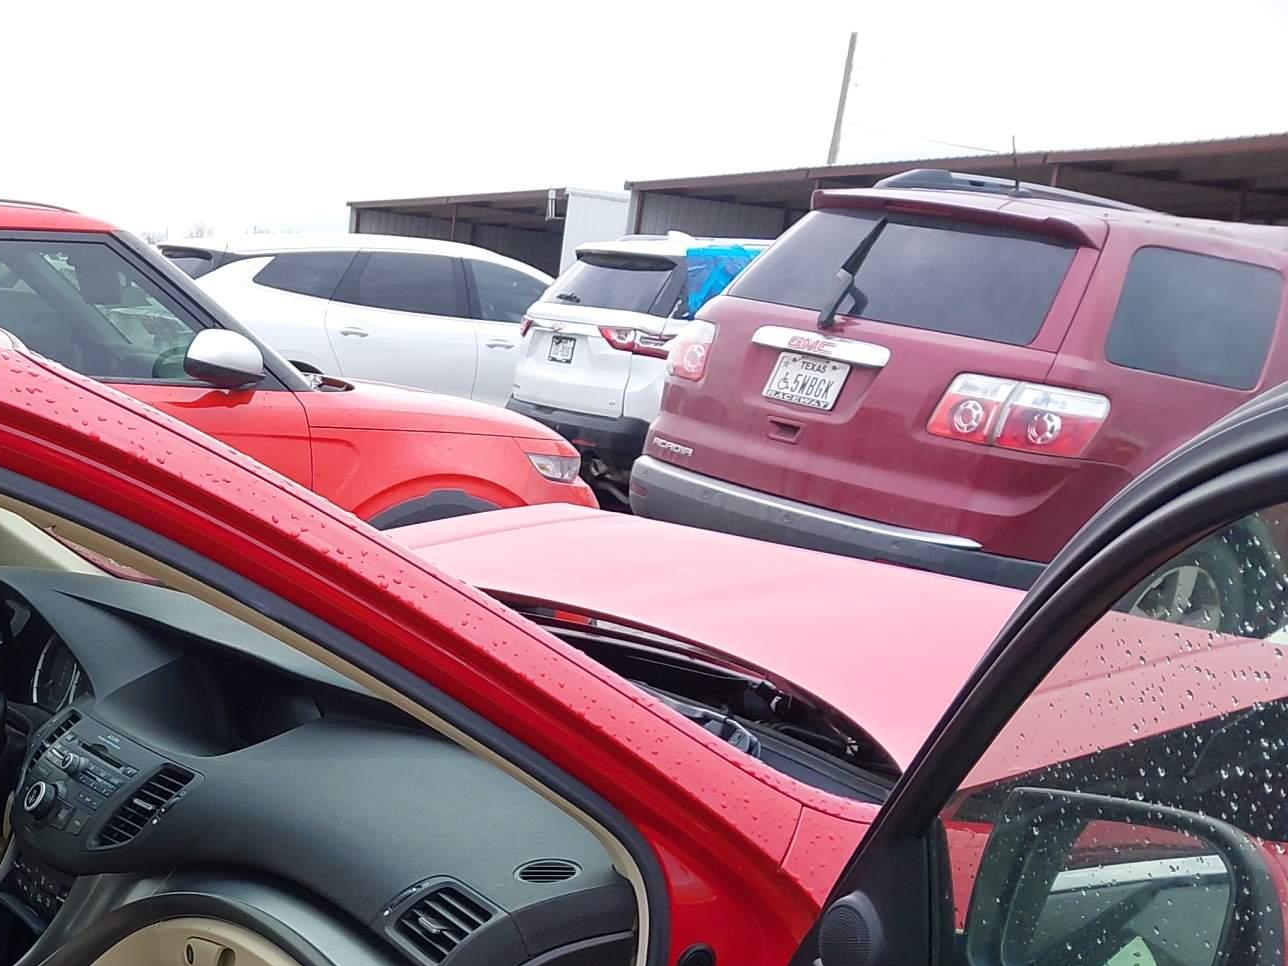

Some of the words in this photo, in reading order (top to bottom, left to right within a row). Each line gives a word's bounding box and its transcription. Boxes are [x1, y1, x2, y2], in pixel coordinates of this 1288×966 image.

[787, 335, 836, 356] GMC
[800, 360, 828, 374] TEXAS
[652, 436, 694, 457] ACADIA
